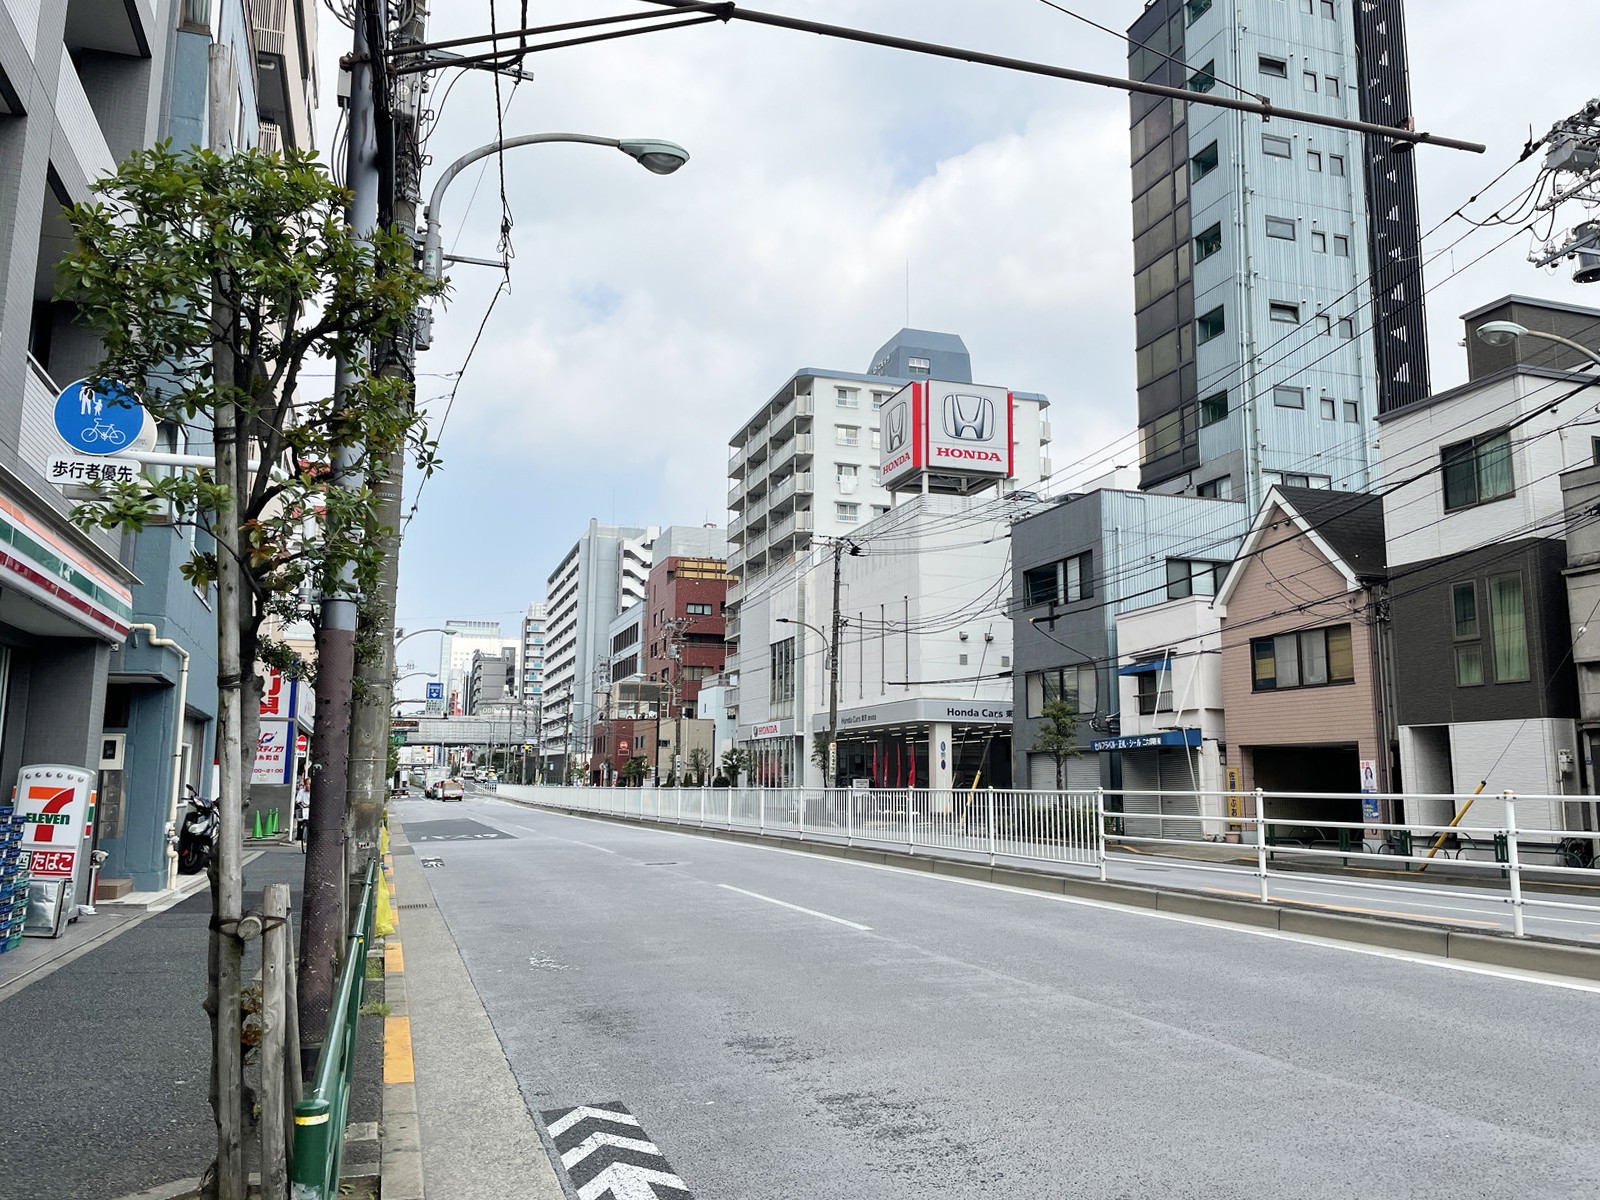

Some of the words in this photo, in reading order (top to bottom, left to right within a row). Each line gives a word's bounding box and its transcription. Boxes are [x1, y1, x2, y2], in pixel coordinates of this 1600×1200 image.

[936, 447, 1002, 462] HONDA
[52, 460, 133, 482] 歩行者優先
[882, 452, 911, 475] HONDA
[946, 707, 979, 717] Honda
[981, 708, 1004, 718] Cars
[758, 724, 778, 735] HONDA
[31, 852, 73, 871] たばこ
